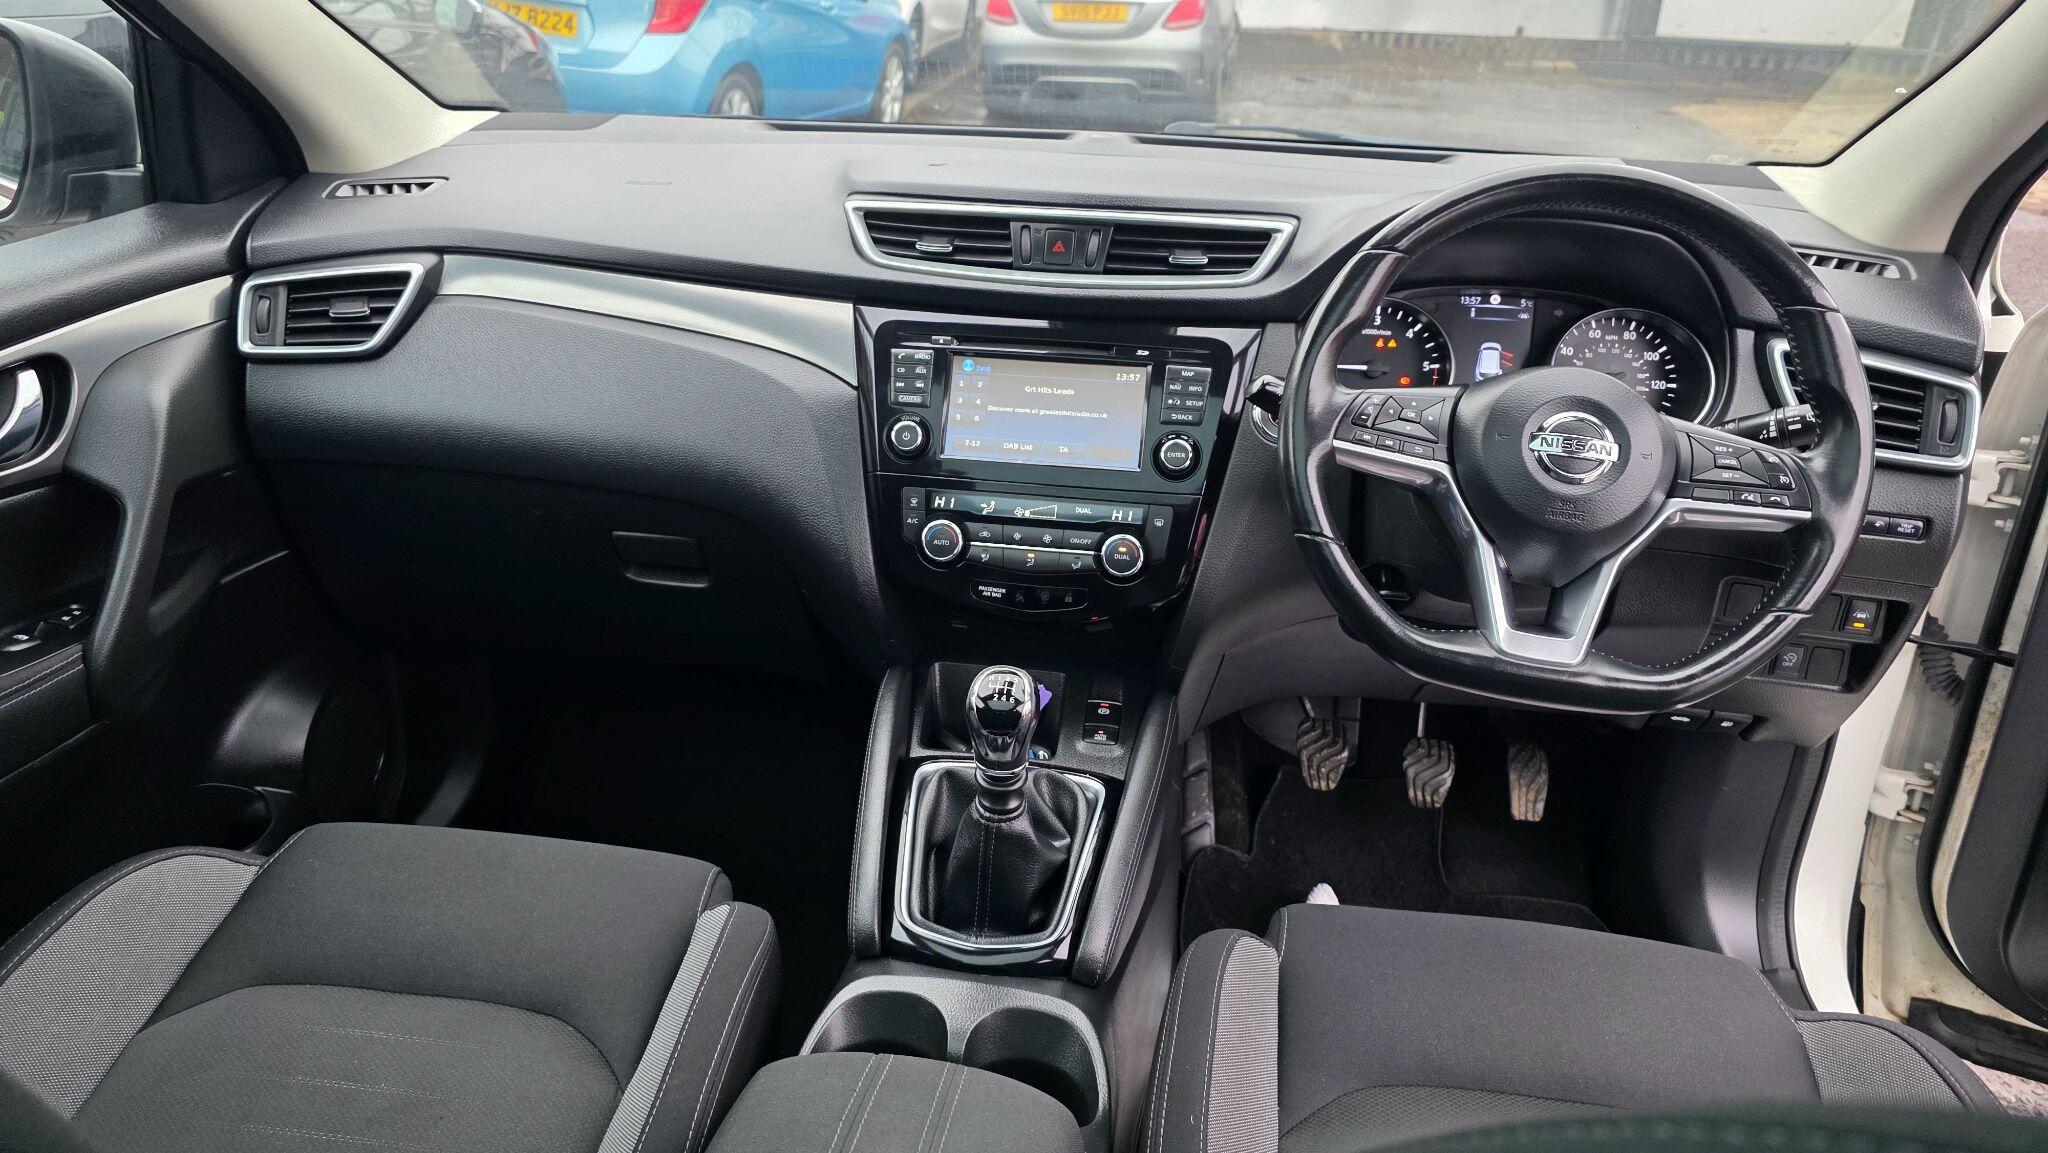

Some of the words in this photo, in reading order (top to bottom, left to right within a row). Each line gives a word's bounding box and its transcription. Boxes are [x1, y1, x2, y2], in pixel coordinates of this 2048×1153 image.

[1460, 296, 1482, 305] 13:57
[1373, 316, 1381, 326] 3
[1405, 329, 1414, 339] 4
[1588, 330, 1601, 339] 60
[1623, 331, 1637, 340] 80
[1560, 347, 1574, 356] 40
[1643, 352, 1660, 361] 100
[1422, 361, 1430, 371] 5
[1115, 373, 1141, 381] 13:57
[1650, 380, 1666, 389] 120
[1038, 386, 1052, 394] Hits
[1053, 387, 1075, 395] Leeds
[898, 395, 923, 403] CAMERA
[987, 405, 1013, 413] Discover
[1039, 409, 1108, 418] greatesthitsradio.co.uk
[965, 439, 981, 447] 7-12
[1539, 436, 1612, 457] NISSAN
[1558, 501, 1577, 509] SRS
[1545, 510, 1585, 521] AIRBAG
[978, 585, 1006, 593] PASSENGER
[1010, 696, 1015, 704] 6
